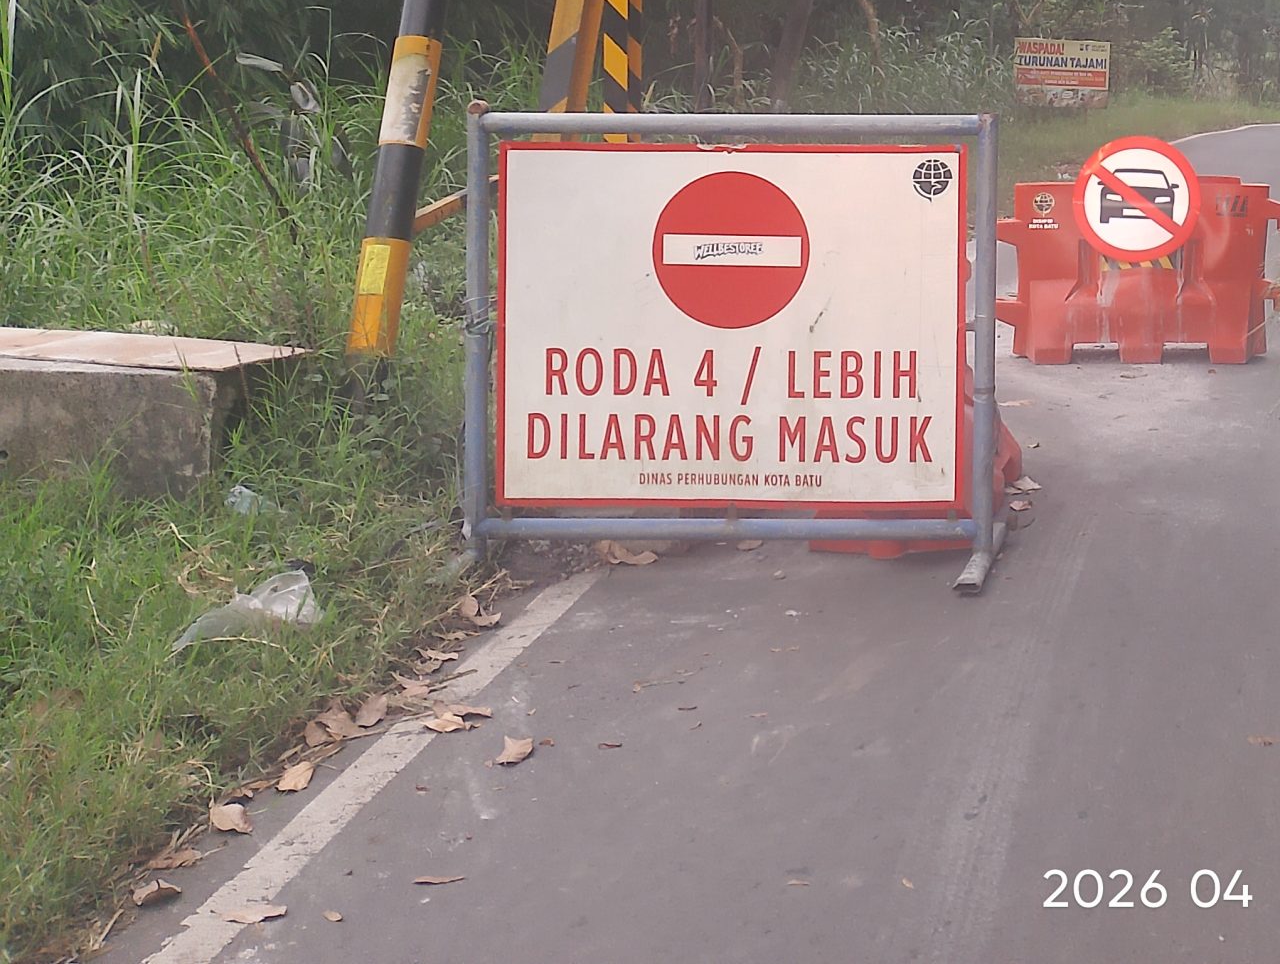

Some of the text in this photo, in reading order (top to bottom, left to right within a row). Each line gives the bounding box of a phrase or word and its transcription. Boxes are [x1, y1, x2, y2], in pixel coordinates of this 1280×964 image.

[1018, 55, 1068, 67] TURUNAN
[545, 346, 918, 406] RODA 4 / LEBIH
[526, 413, 933, 464] DILARANG MASUK
[639, 472, 822, 488] DINAS PERHUBUNGAN KOTA BATU
